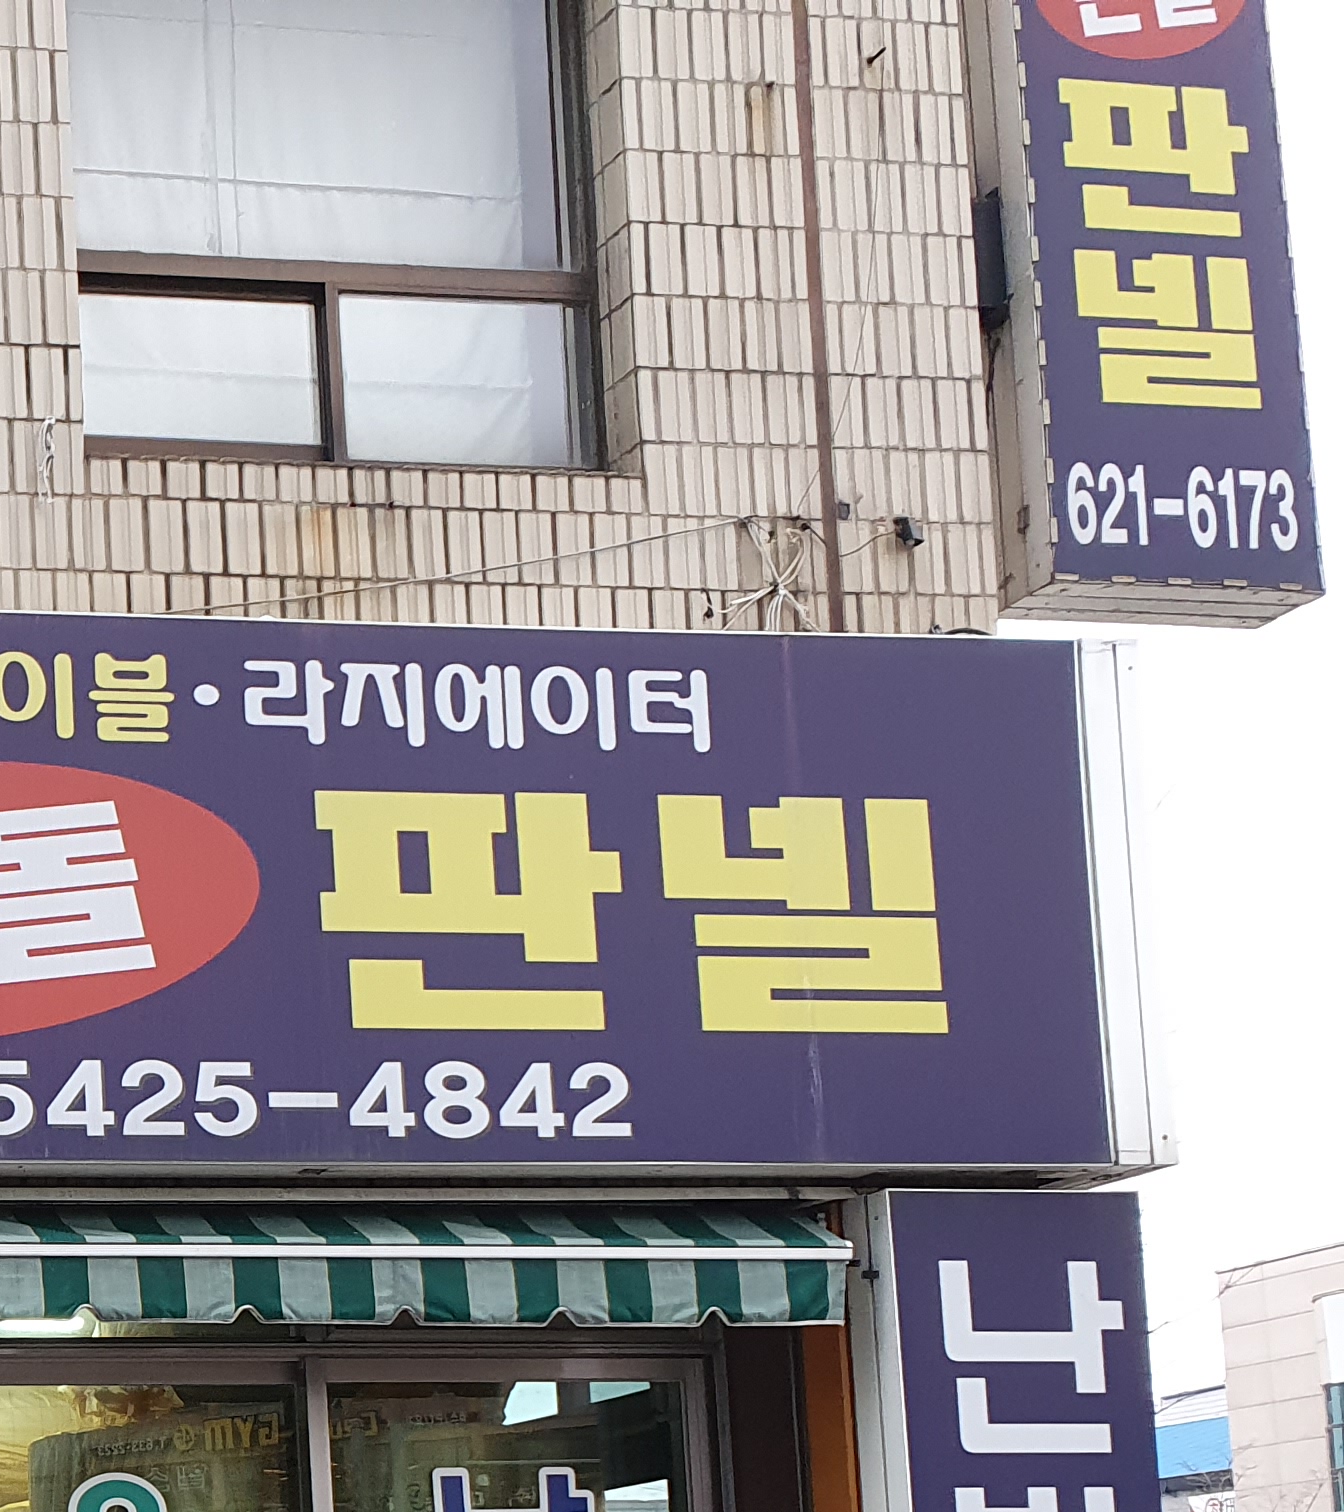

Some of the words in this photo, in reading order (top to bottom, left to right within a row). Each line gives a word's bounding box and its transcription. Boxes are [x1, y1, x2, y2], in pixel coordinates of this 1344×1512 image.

[1059, 78, 1262, 409] 판넬
[1066, 461, 1299, 552] 621-6173
[243, 659, 711, 753] 라지에이터
[316, 790, 950, 1034] 판넬
